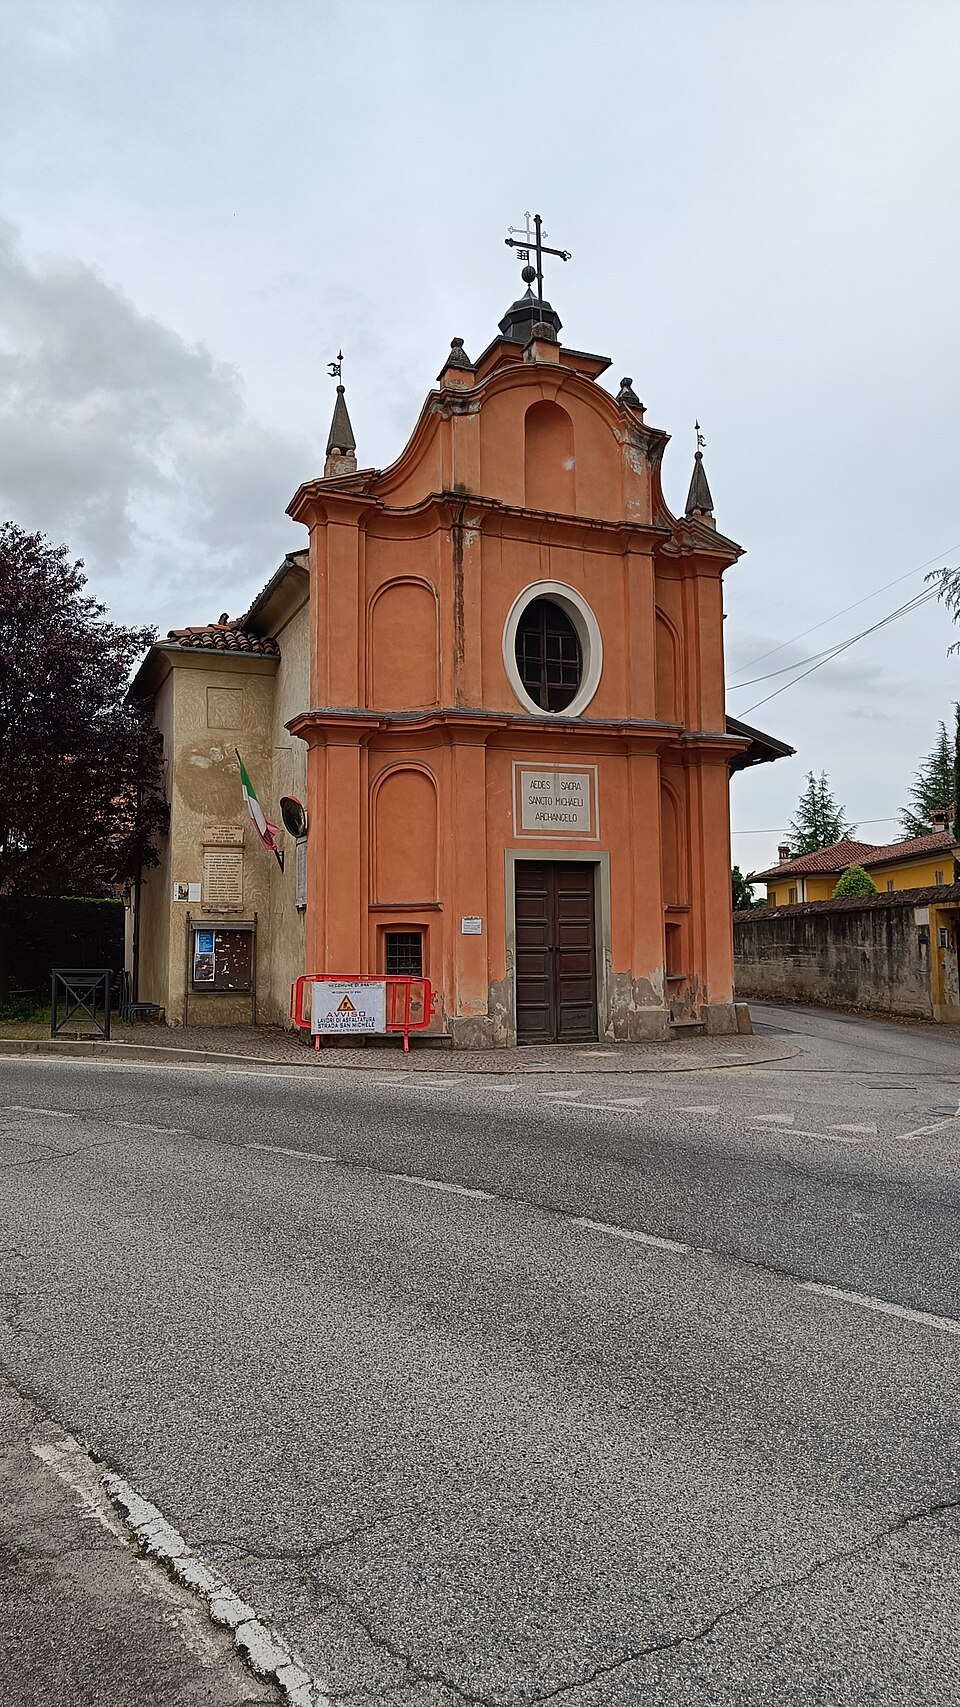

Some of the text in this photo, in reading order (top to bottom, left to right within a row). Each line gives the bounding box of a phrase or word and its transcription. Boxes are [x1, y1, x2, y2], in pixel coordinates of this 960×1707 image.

[530, 780, 582, 791] AEDES SACRA
[528, 796, 584, 807] SANCTO MICHAELI
